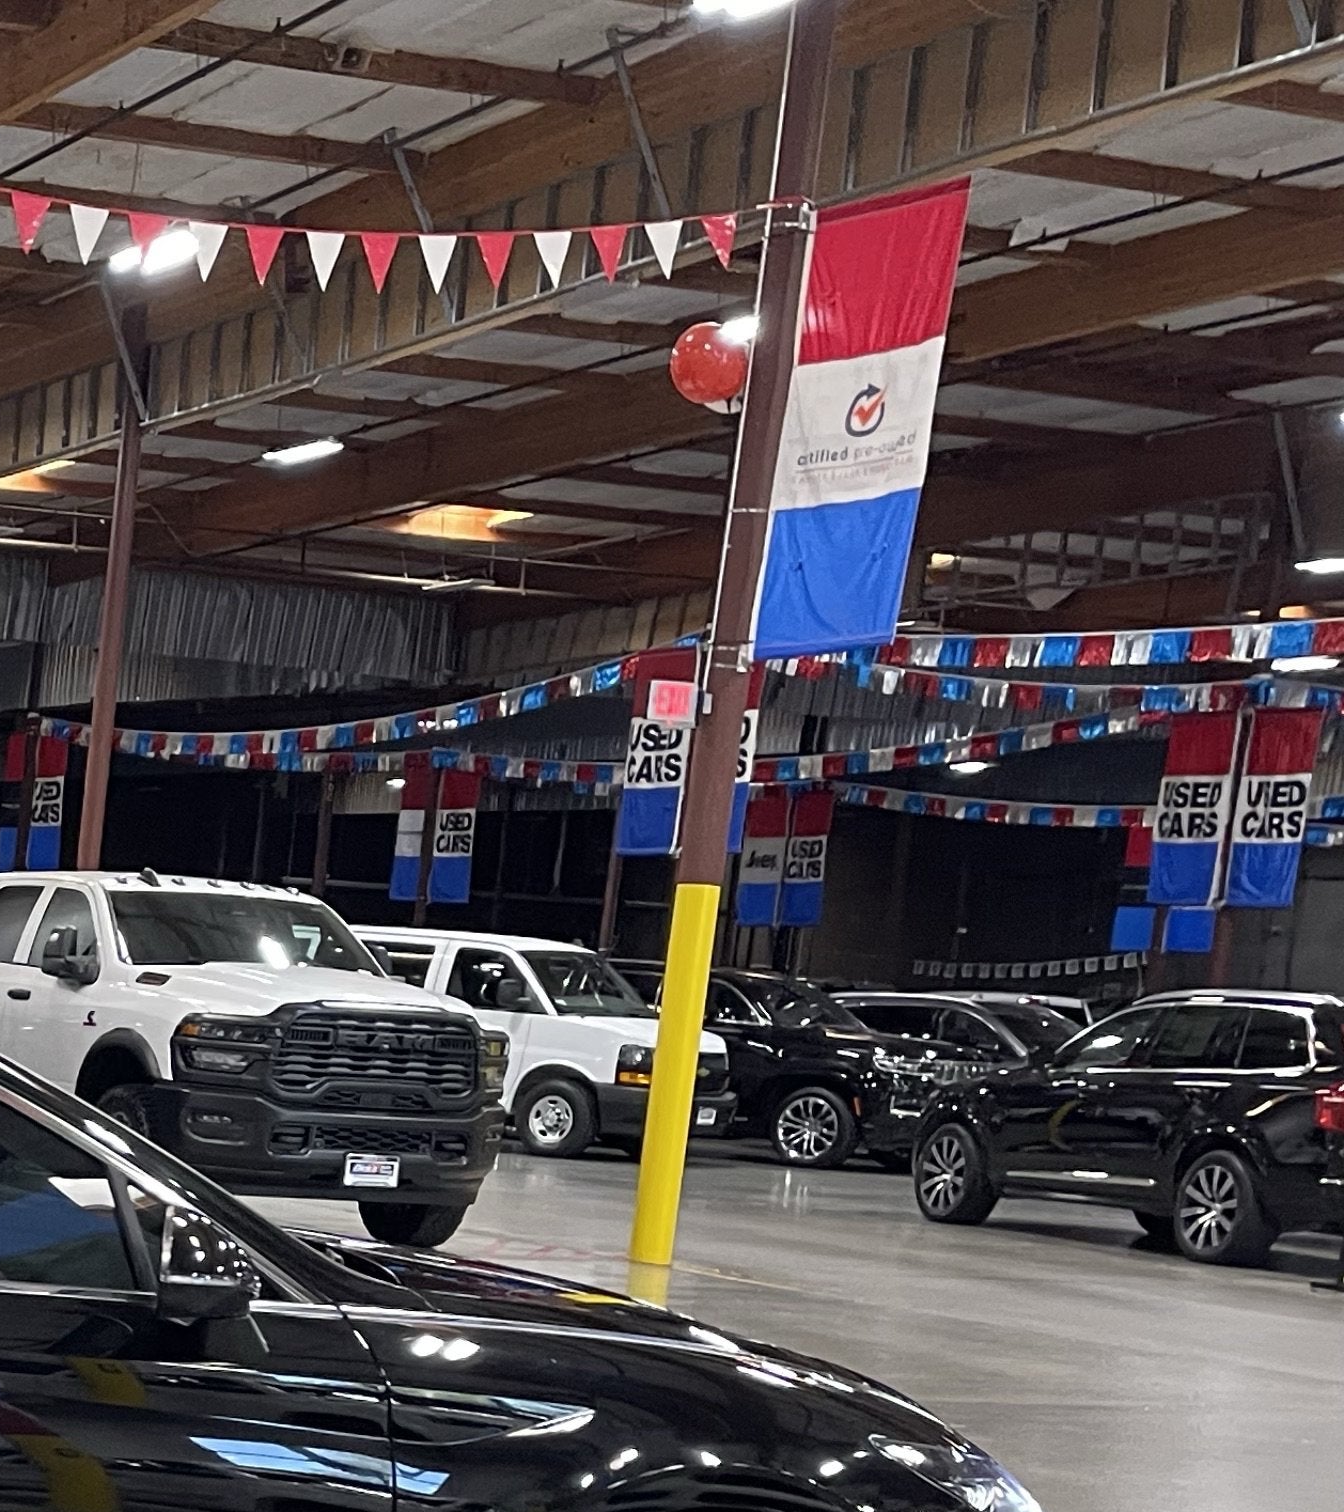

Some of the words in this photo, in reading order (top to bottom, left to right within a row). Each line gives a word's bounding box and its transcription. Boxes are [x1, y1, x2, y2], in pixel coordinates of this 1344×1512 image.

[626, 753, 682, 783] CARS
[1163, 781, 1222, 808] USED
[1158, 811, 1218, 838] CARS
[336, 1029, 435, 1050] RAM
